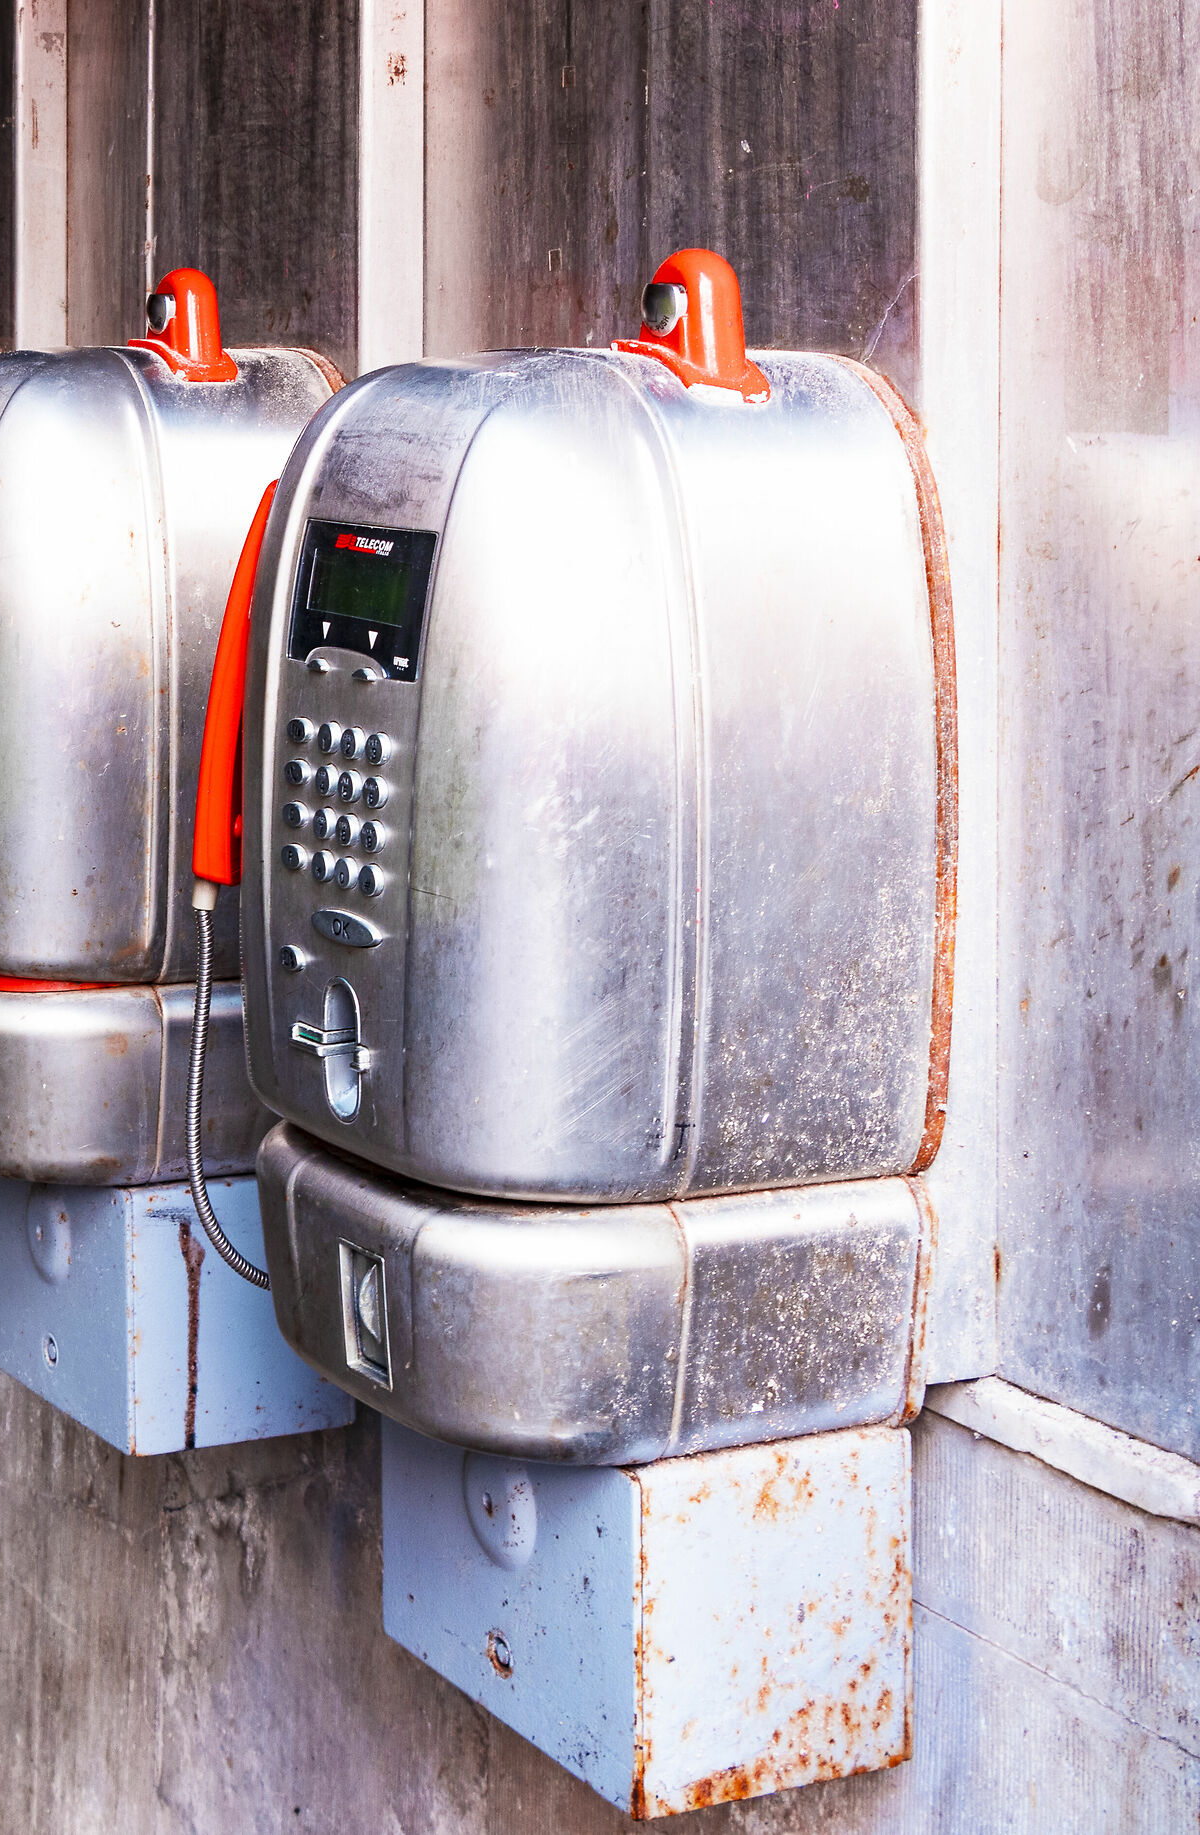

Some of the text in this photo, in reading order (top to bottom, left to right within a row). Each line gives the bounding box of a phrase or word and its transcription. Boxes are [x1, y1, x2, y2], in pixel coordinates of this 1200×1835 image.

[655, 315, 670, 332] PUSH
[355, 536, 394, 552] TELECOM
[332, 918, 350, 940] OK
